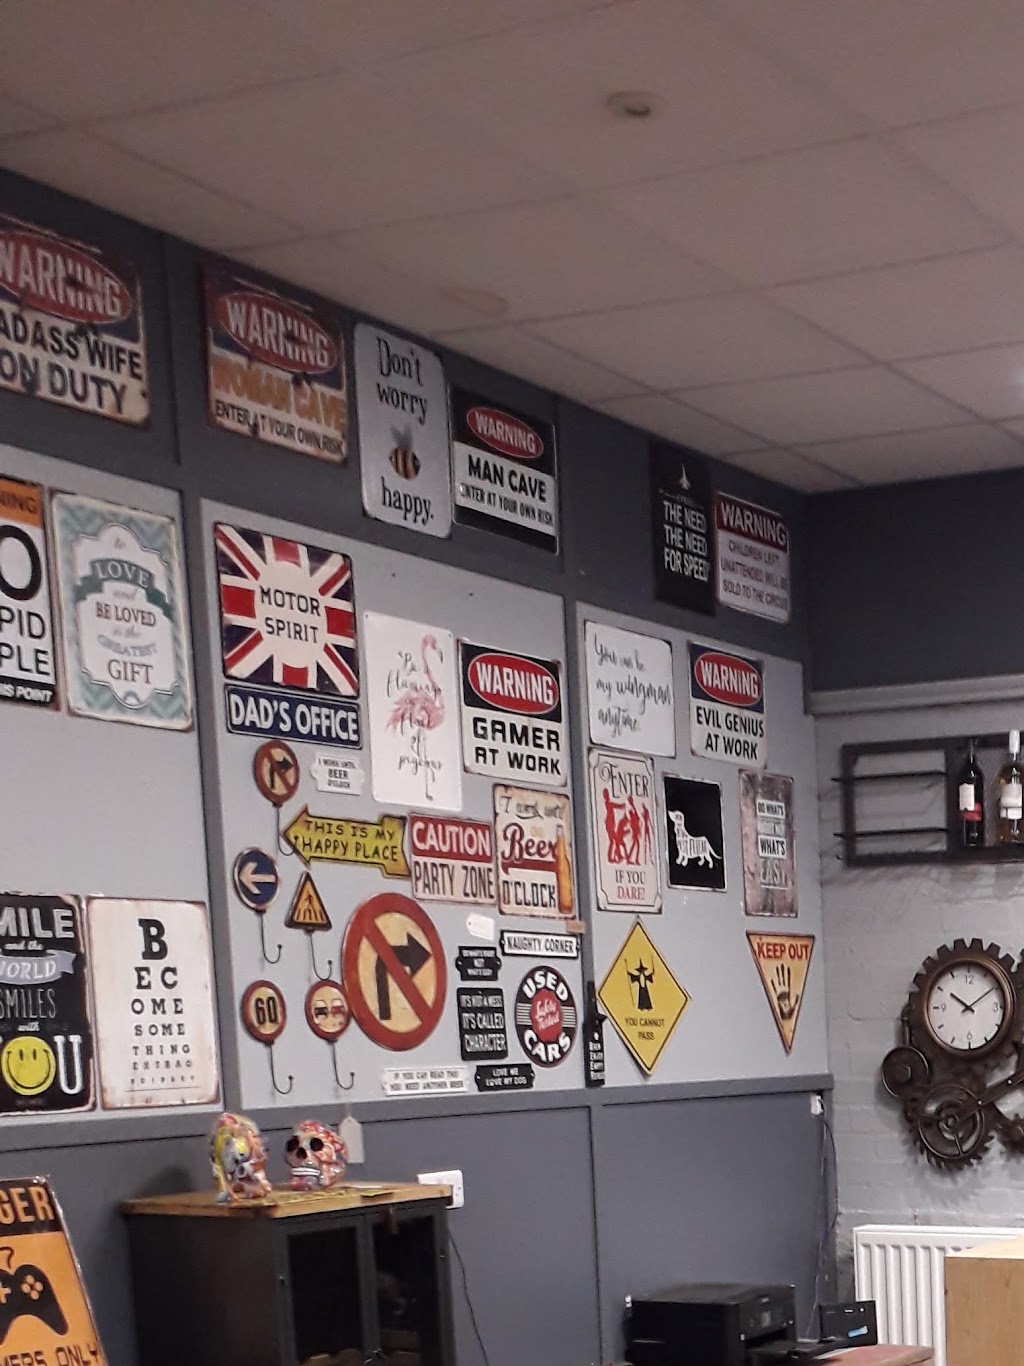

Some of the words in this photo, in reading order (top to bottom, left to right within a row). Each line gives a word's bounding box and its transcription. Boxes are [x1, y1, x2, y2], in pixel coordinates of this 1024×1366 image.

[227, 298, 330, 368] WARNING
[85, 332, 143, 381] WIFE
[376, 336, 425, 387] Don't
[48, 362, 128, 414] DUTY
[376, 381, 429, 426] worry
[473, 410, 538, 455] WARNING
[468, 454, 504, 488] MAN
[508, 469, 547, 504] CAVE
[381, 475, 435, 527] happy.
[663, 501, 684, 525] THE
[663, 524, 684, 549] THE
[721, 501, 788, 546] WARNING
[95, 561, 150, 589] LOVE
[664, 547, 683, 574] FOR
[95, 601, 111, 620] BE
[114, 605, 157, 628] LOVED
[260, 584, 321, 617] MOTOR
[265, 617, 319, 643] SPIRIT
[108, 659, 155, 685] GIFT
[475, 662, 555, 707] WARNING
[699, 660, 760, 700] WARNING
[596, 678, 612, 702] my
[616, 674, 672, 716] wingman
[229, 692, 293, 732] DAD'S
[295, 705, 360, 744] OFFICE
[696, 706, 723, 728] EVIL
[725, 714, 765, 739] GENIUS
[472, 716, 561, 752] GAMER
[705, 731, 722, 753] AT
[723, 735, 759, 761] WORK
[328, 769, 349, 780] BEER
[475, 747, 500, 766] AT
[508, 754, 562, 776] WORK
[304, 820, 344, 836] THIS
[351, 825, 368, 839] IS
[375, 828, 396, 841] MY
[412, 820, 491, 858] CAUTION
[501, 822, 558, 862] Beer
[301, 836, 348, 858] HAPPY
[354, 842, 399, 862] PLACE
[760, 838, 786, 857] WHAT'S
[414, 862, 456, 898] PARTY
[462, 864, 495, 901] ZONE
[615, 870, 625, 884] IF
[626, 871, 646, 885] YOU
[502, 880, 557, 909] O'CLOCK
[617, 886, 646, 901] DARE!
[138, 918, 169, 961] B
[507, 938, 542, 951] NAUGHTY
[544, 940, 575, 954] CORNER
[757, 942, 786, 960] KEEP
[788, 942, 810, 961] OUT
[522, 970, 569, 1001] USED
[964, 974, 975, 985] 12
[254, 996, 278, 1026] 60
[462, 1012, 477, 1030] IT'S
[477, 1012, 504, 1030] CALLED
[941, 1003, 947, 1013] 9
[993, 1002, 999, 1012] 3
[624, 1017, 637, 1028] YOU
[638, 1017, 665, 1028] CANNOT
[637, 1031, 655, 1041] PASS
[966, 1031, 973, 1042] 6
[464, 1033, 507, 1053] CHARACTER
[523, 1029, 572, 1062] CARS
